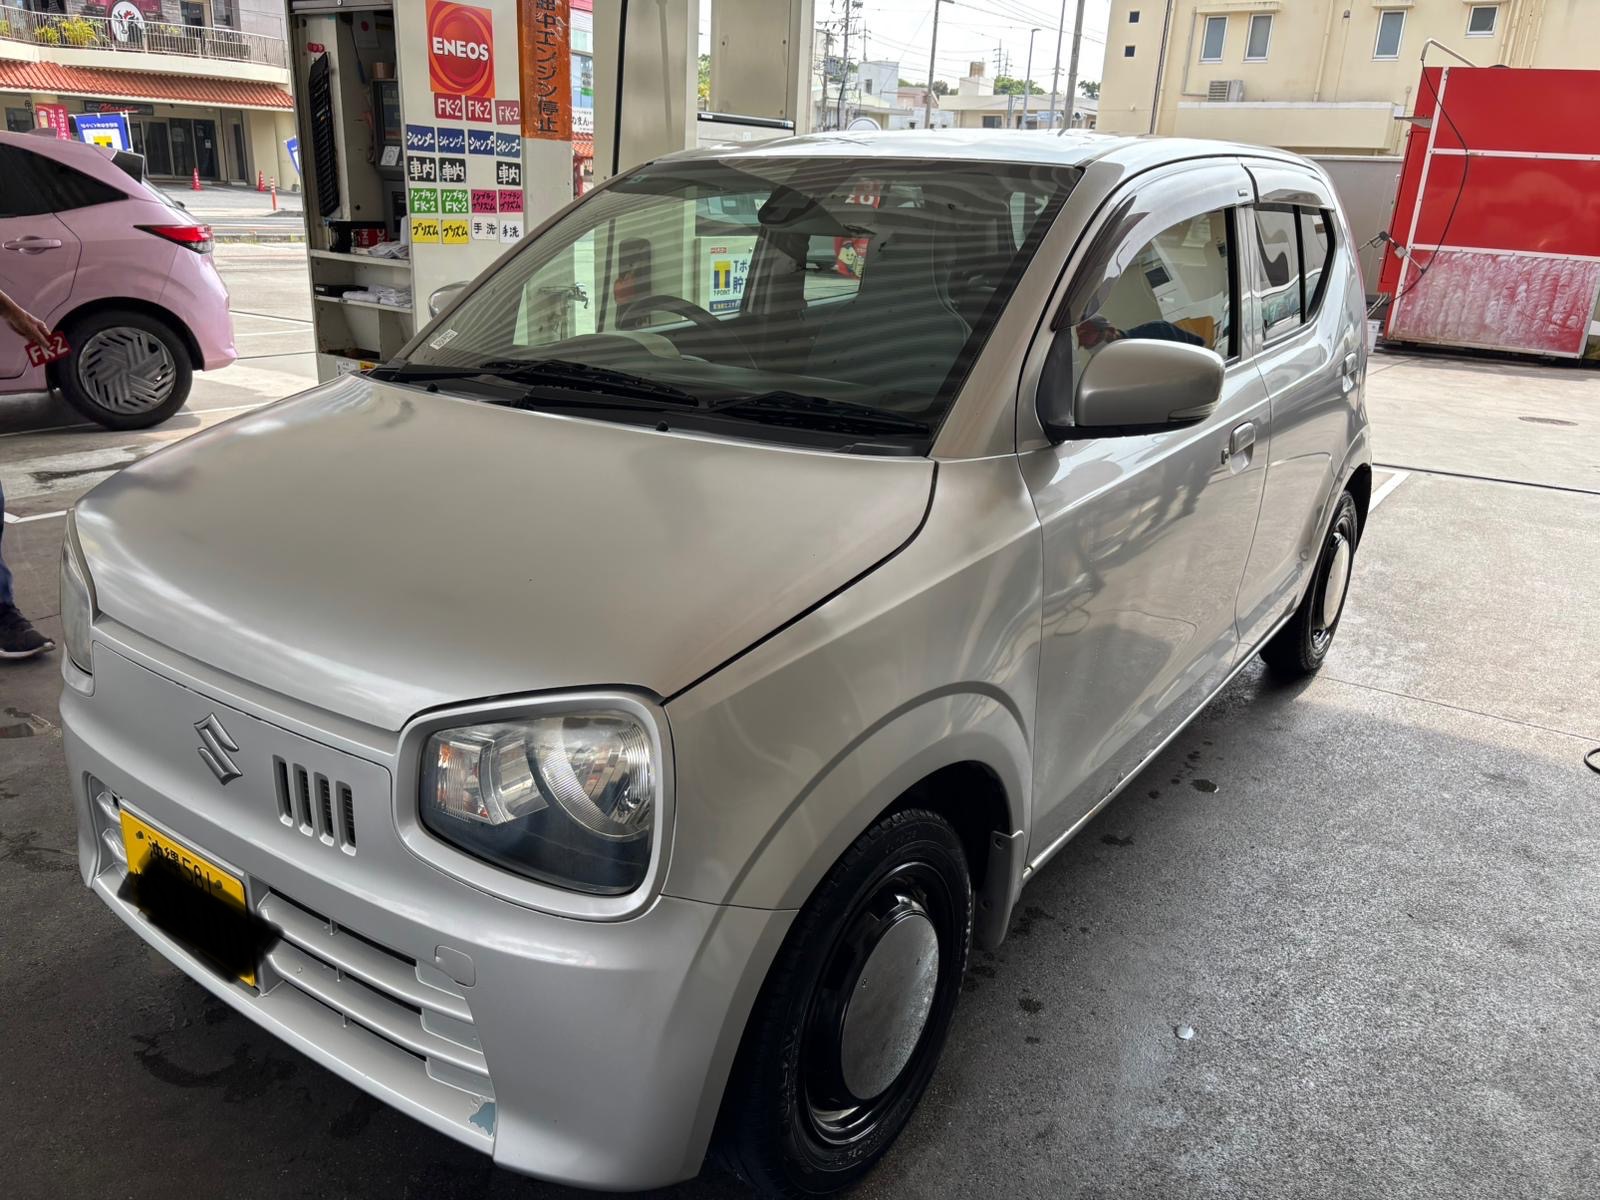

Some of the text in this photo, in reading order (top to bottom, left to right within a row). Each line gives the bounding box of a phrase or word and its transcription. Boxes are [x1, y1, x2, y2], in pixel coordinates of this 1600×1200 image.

[432, 37, 489, 62] ENEOS
[438, 98, 462, 116] FK-2
[467, 100, 491, 118] FK-2
[498, 106, 520, 122] FK-2
[409, 158, 435, 180] 車内
[442, 161, 465, 182] 車内
[498, 164, 519, 184] 車内
[413, 201, 436, 212] FK-2
[445, 202, 467, 212] FK-2
[412, 222, 439, 236] プリズム
[502, 224, 520, 238] 手洗
[29, 336, 68, 363] FK-2
